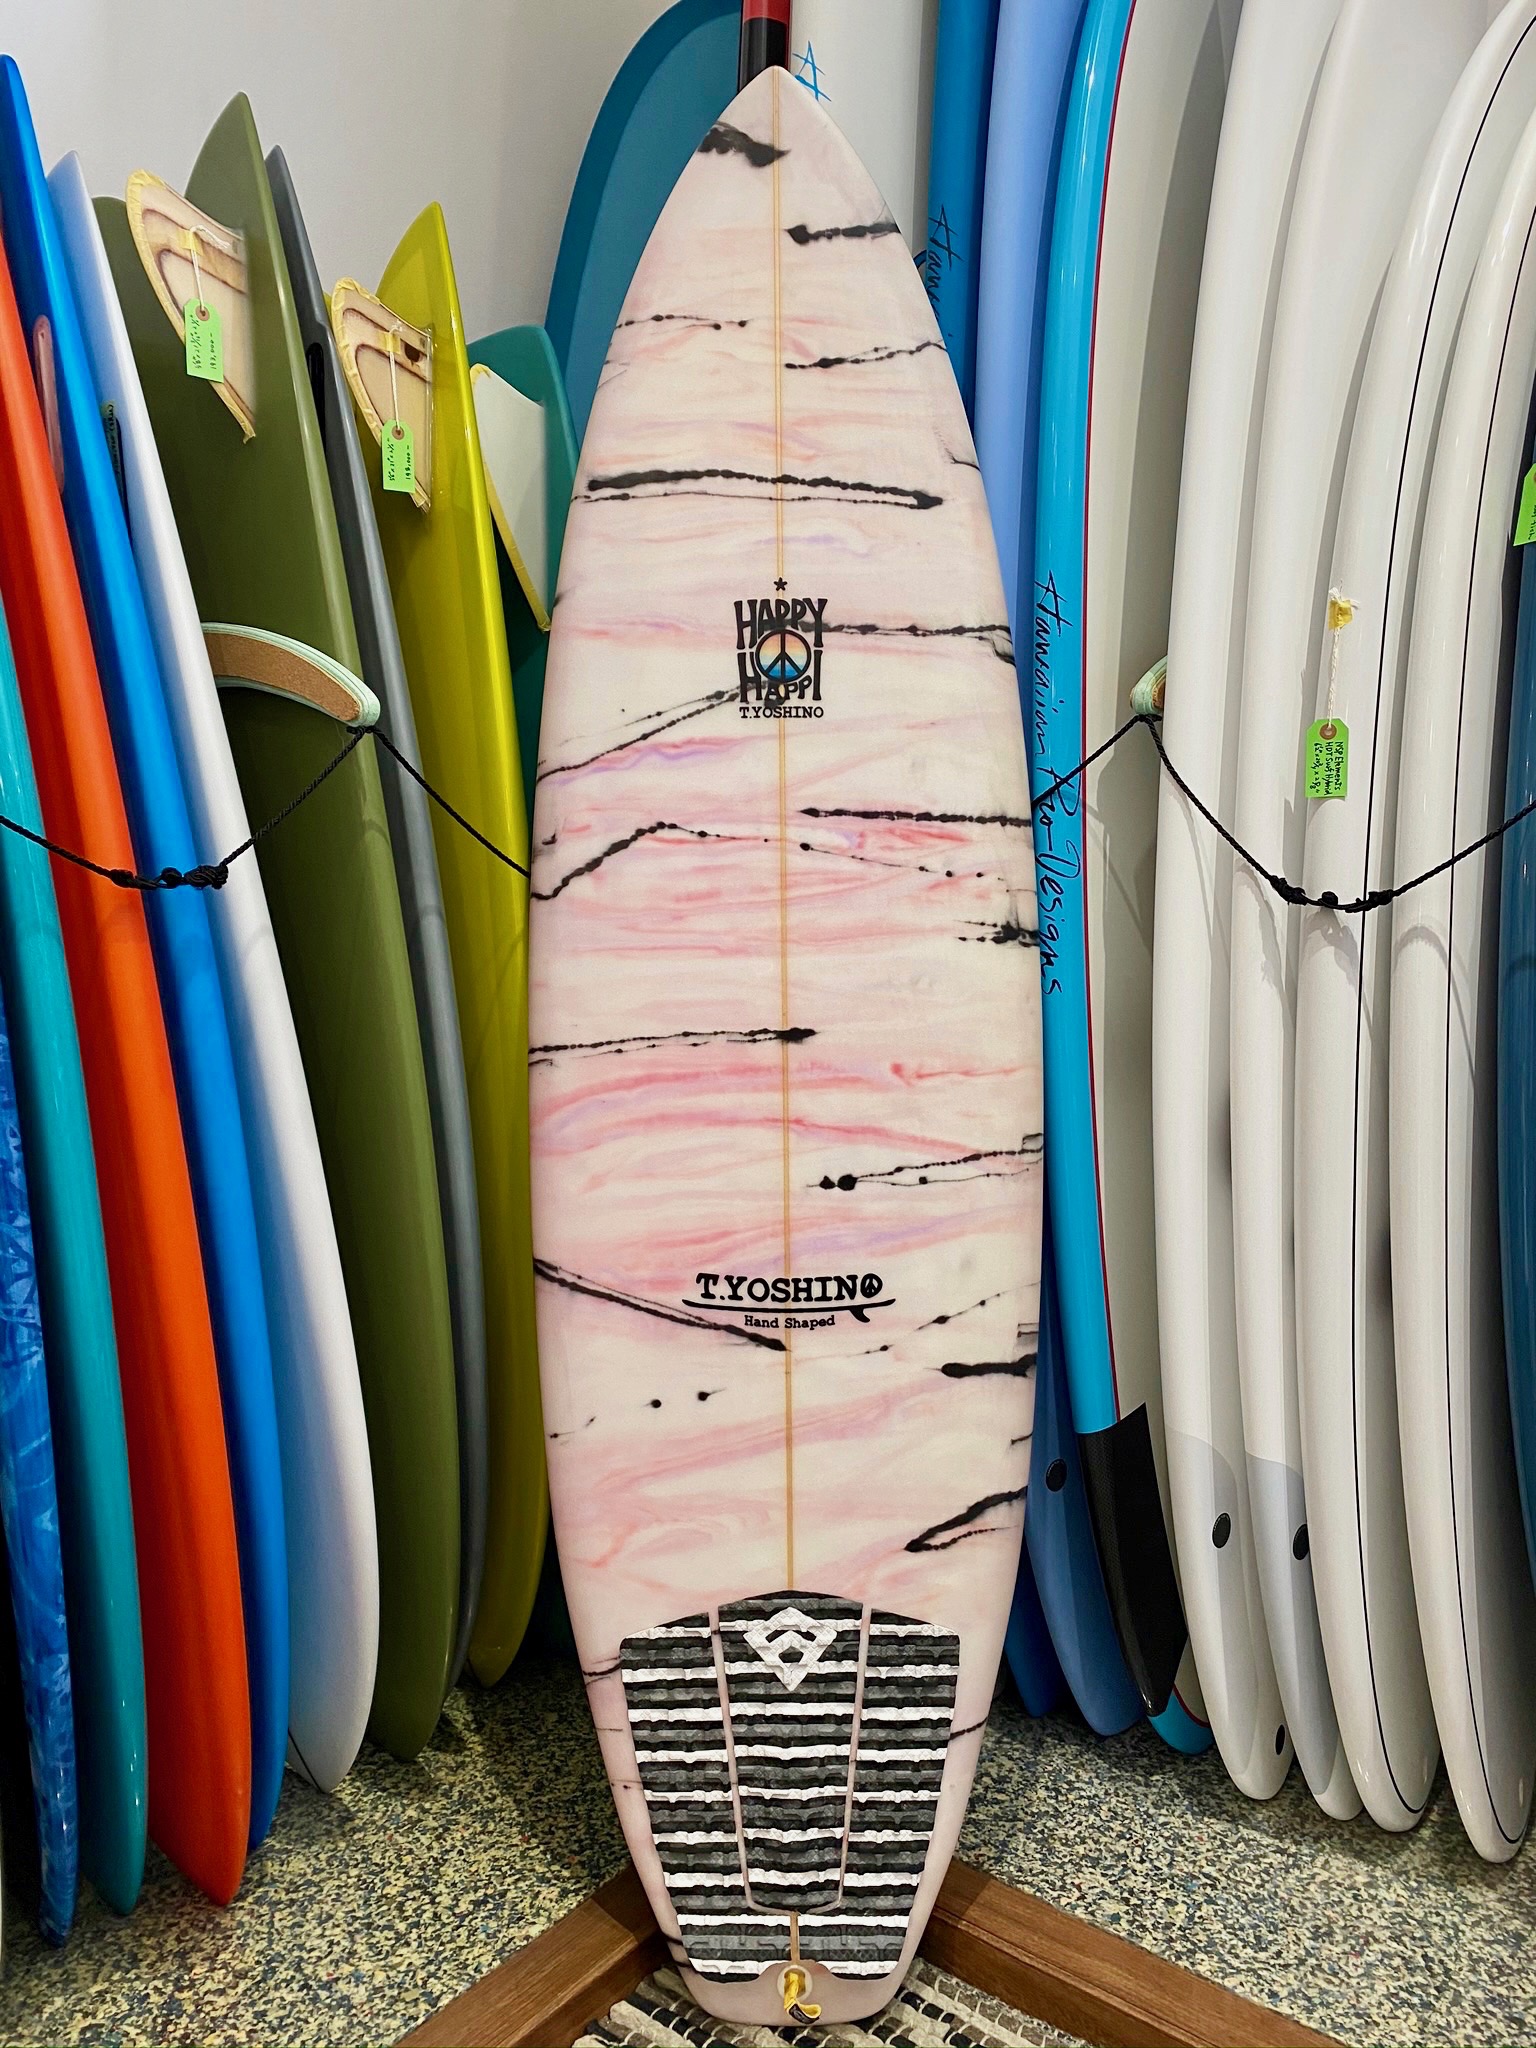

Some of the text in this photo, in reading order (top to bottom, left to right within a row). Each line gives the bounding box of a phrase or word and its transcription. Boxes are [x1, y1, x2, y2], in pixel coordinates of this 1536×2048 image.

[733, 597, 828, 649] HAPPY
[1034, 569, 1073, 757] Hawaiian
[739, 706, 825, 719] T.YOSHINO
[695, 1272, 884, 1304] T.YOSHINO
[744, 1314, 836, 1331] Hand Shaped
